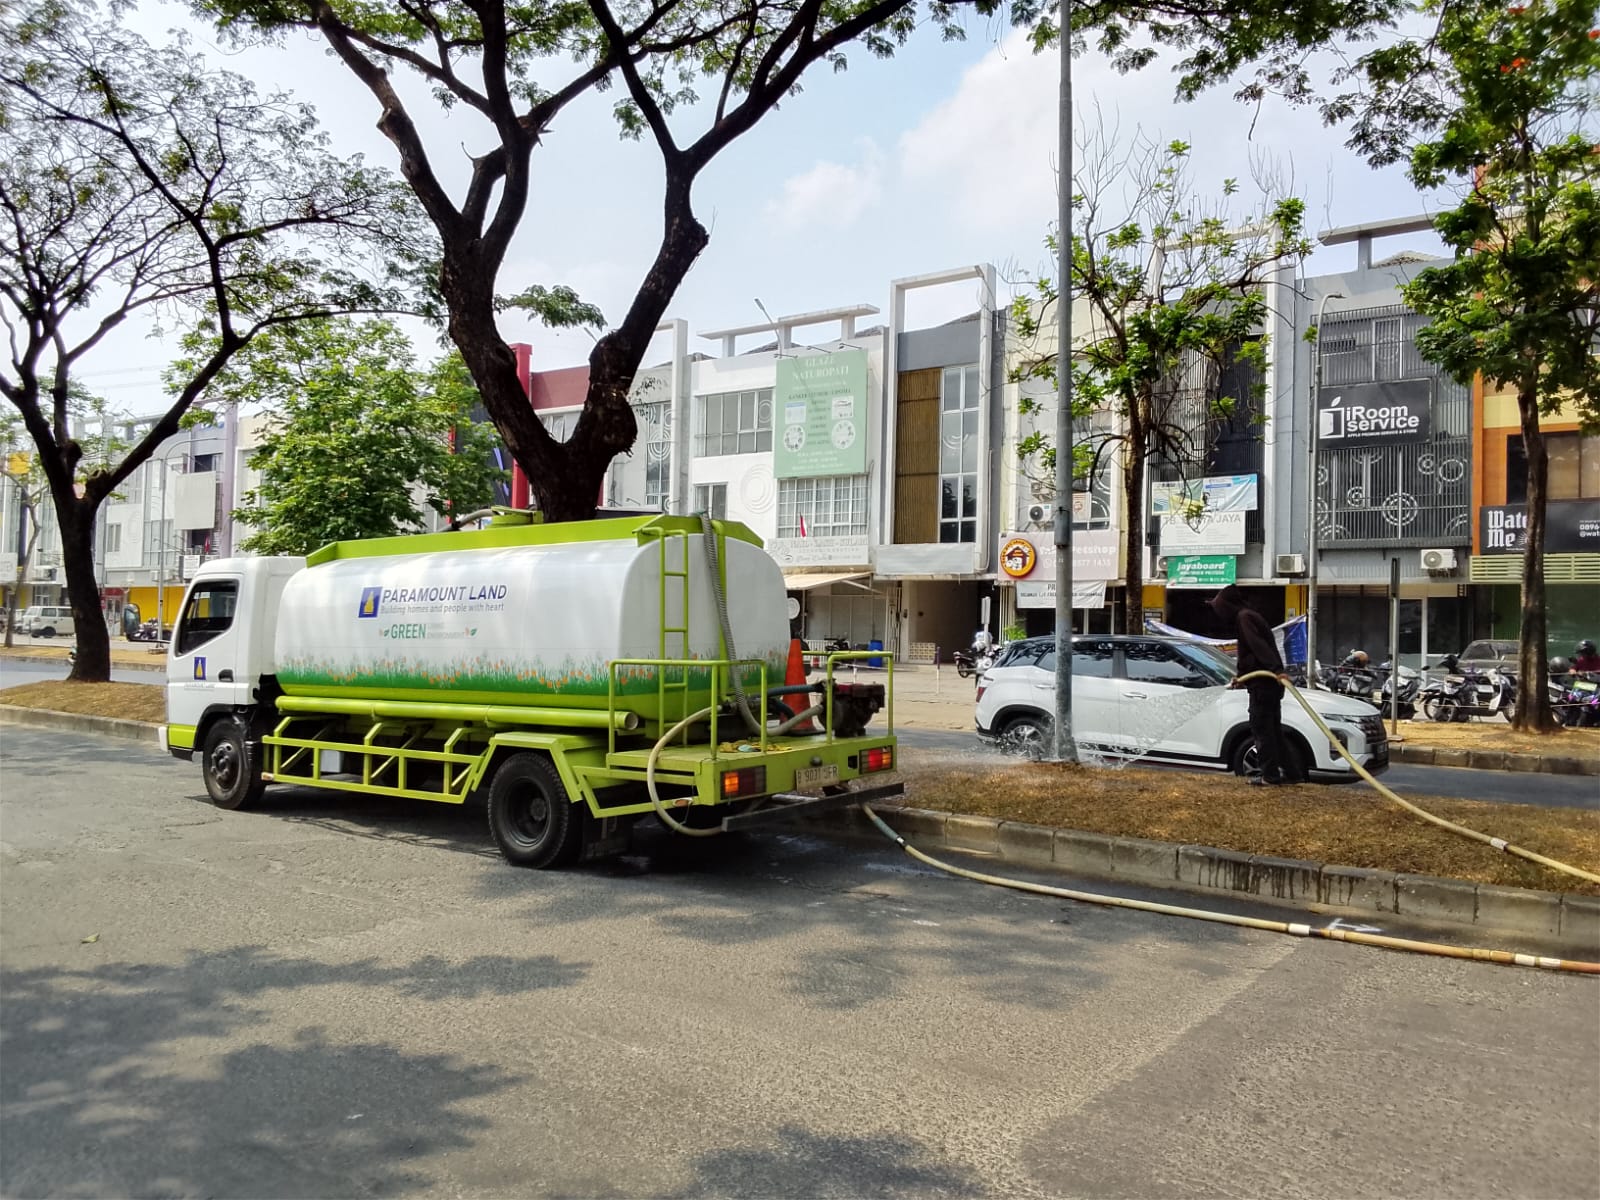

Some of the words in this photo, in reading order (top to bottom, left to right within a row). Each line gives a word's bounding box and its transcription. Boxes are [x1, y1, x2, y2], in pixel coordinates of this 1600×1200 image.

[1346, 405, 1408, 420] iRoom
[1215, 514, 1241, 523] JAYA
[1487, 509, 1528, 529] Watc
[1487, 528, 1516, 548] Me
[1176, 561, 1226, 571] jayaboard
[382, 585, 467, 603] PARAMOUNT
[468, 584, 507, 601] LAND
[408, 604, 429, 613] homes
[443, 603, 468, 615] people
[485, 602, 505, 611] heart
[391, 623, 426, 640] GREEN
